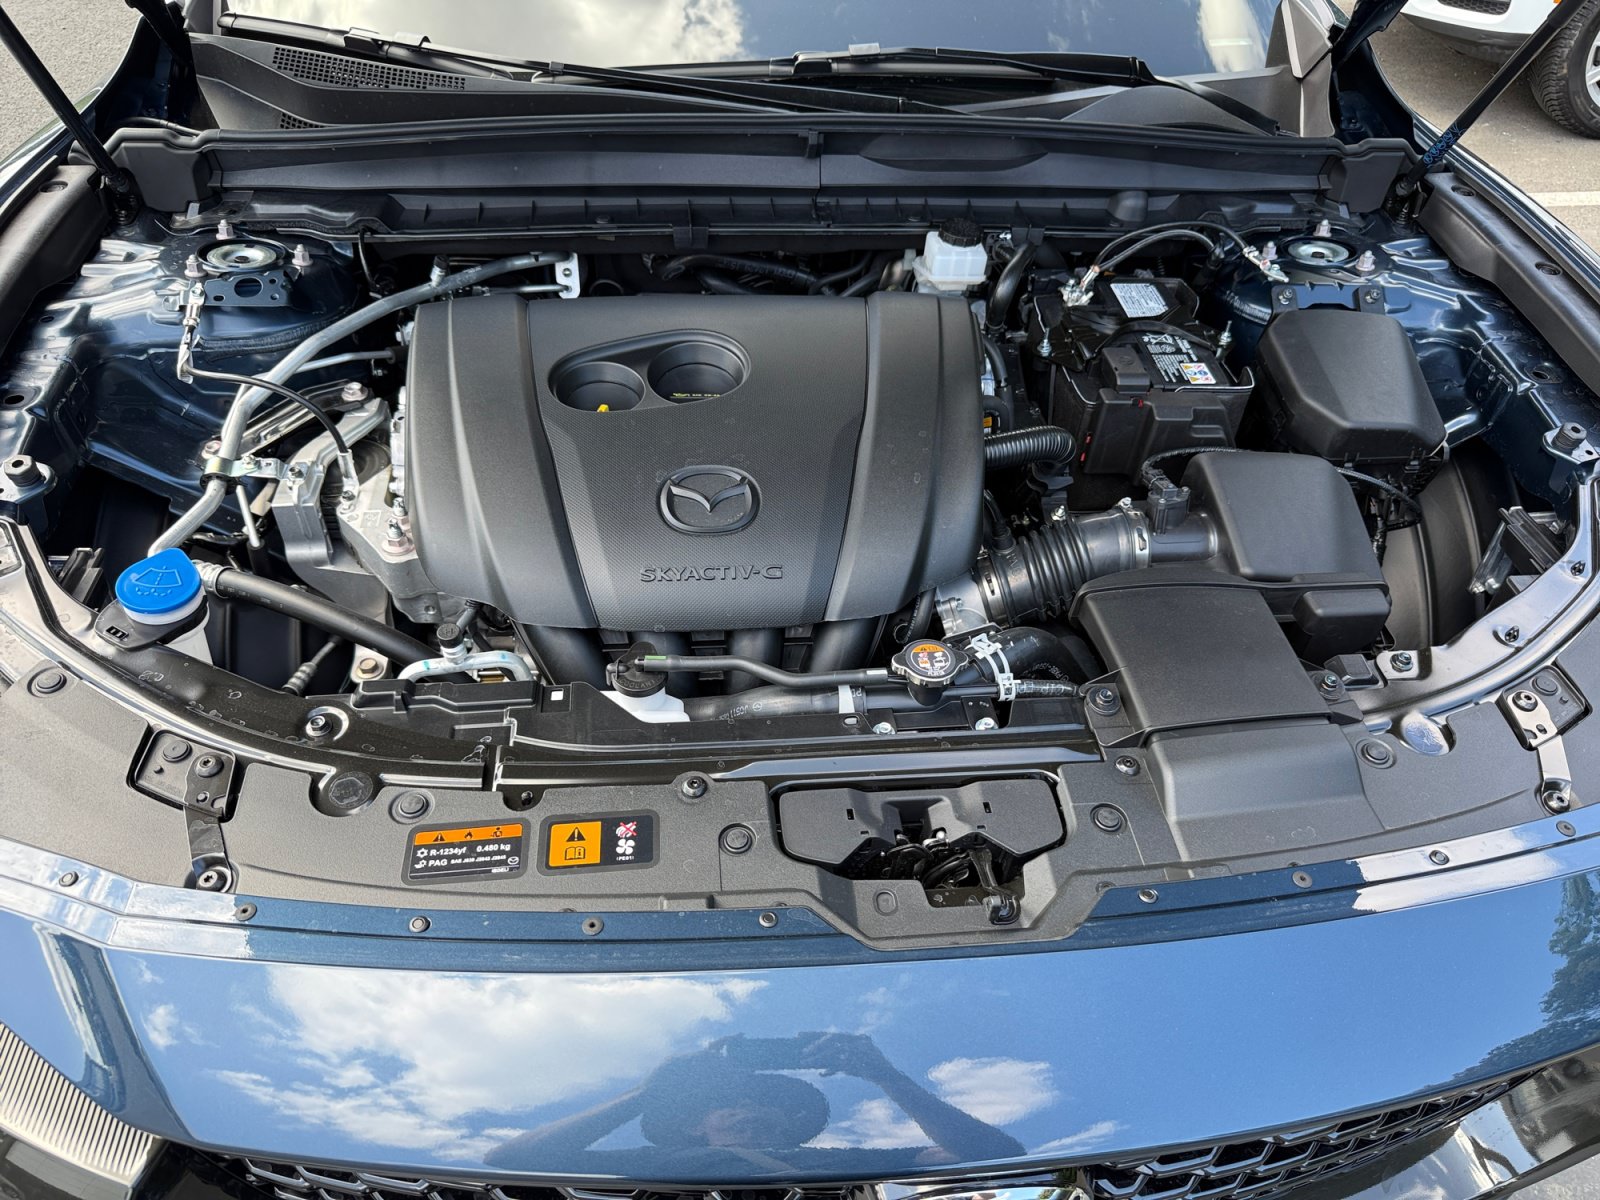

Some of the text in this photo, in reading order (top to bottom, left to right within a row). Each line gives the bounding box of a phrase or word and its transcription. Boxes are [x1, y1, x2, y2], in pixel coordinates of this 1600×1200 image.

[640, 565, 783, 583] SKYACTIV-G
[429, 843, 511, 856] R-1234yf 0.480 kg
[428, 859, 448, 867] PAG
